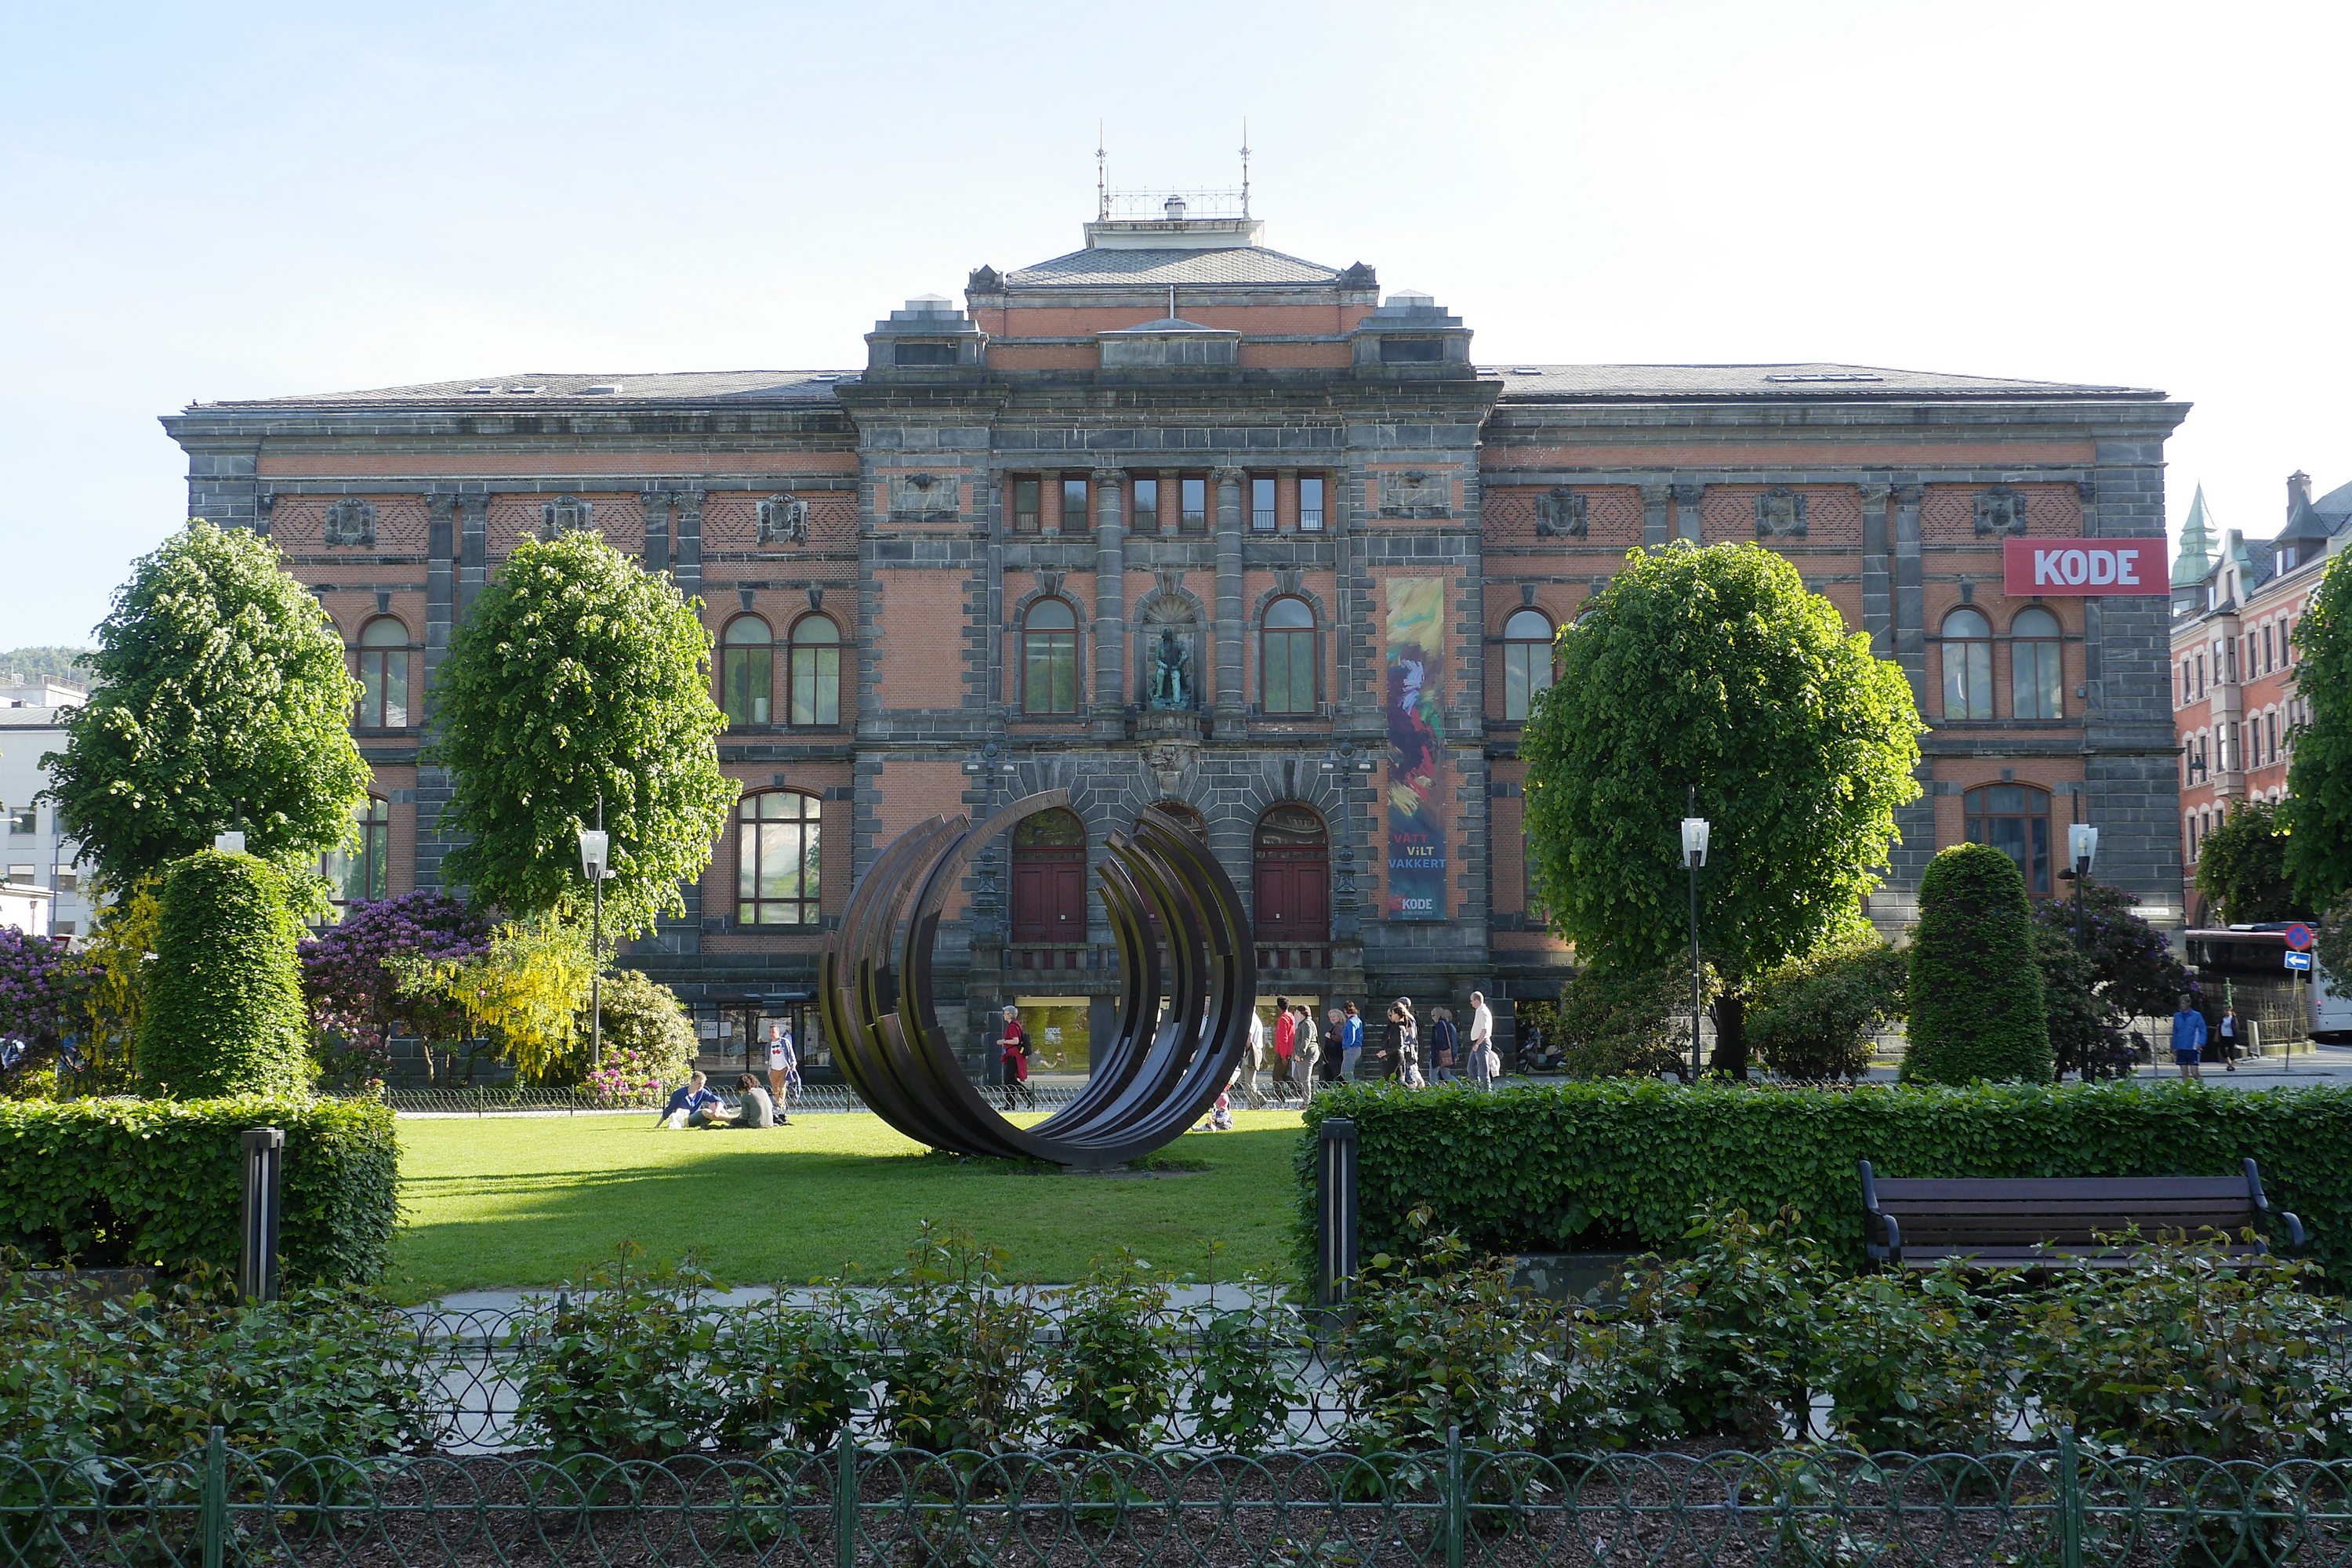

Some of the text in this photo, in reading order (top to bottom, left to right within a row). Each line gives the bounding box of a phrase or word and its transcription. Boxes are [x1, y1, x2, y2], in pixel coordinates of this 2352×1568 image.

[2034, 550, 2140, 585] KODE
[1395, 833, 1428, 843] VÅTT
[1388, 859, 1446, 868] VAKKERT
[1403, 898, 1433, 909] KODE
